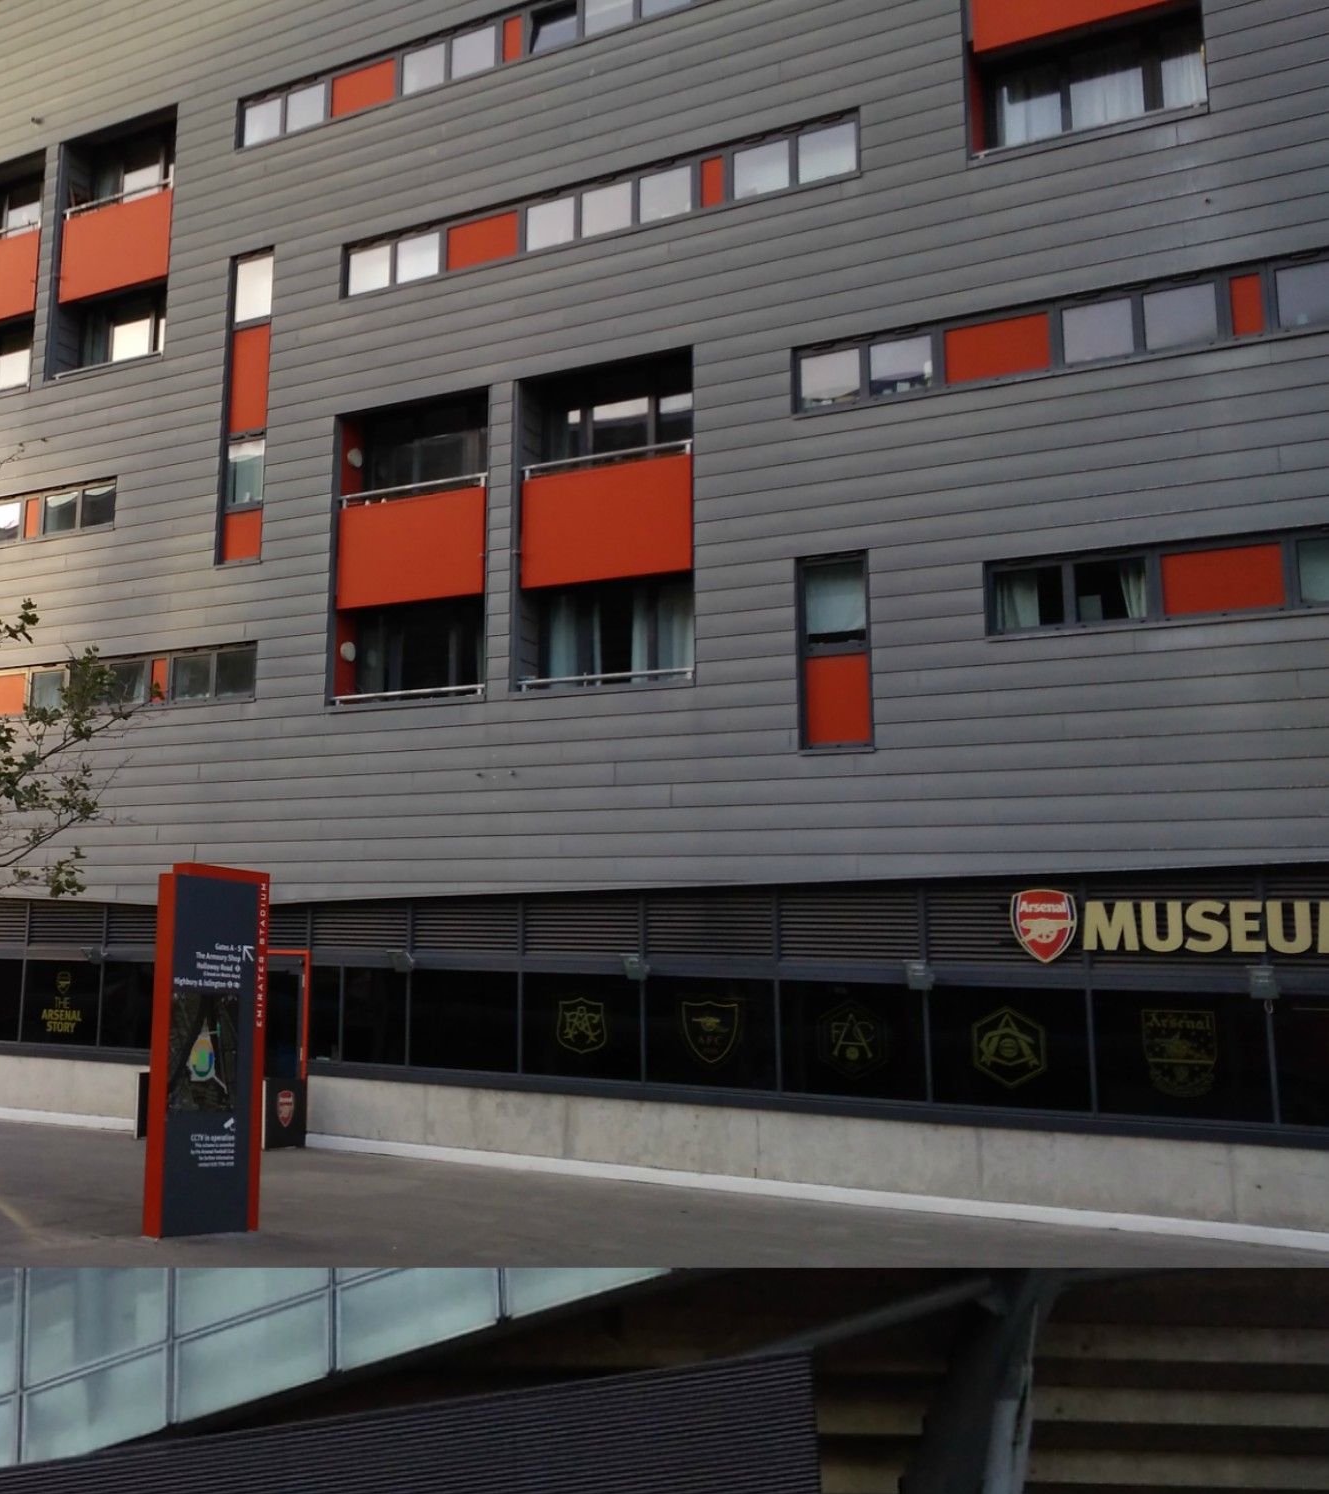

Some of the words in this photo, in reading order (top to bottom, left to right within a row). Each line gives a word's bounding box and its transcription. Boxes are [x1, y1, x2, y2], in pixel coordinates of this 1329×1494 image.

[1020, 901, 1067, 914] Arsenal
[259, 883, 267, 944] STADIUM
[1083, 900, 1329, 953] MUSEU
[215, 943, 229, 951] Gates
[206, 953, 227, 962] Armoury
[228, 954, 241, 963] Shop
[197, 962, 219, 971] Holloway
[174, 977, 197, 987] Highbury
[204, 979, 225, 989] Islington
[256, 956, 264, 1027] EMIRATES
[55, 997, 70, 1008] THE
[41, 1009, 81, 1021] ARSENAL
[46, 1021, 76, 1032] STORY
[211, 1134, 235, 1142] operation
